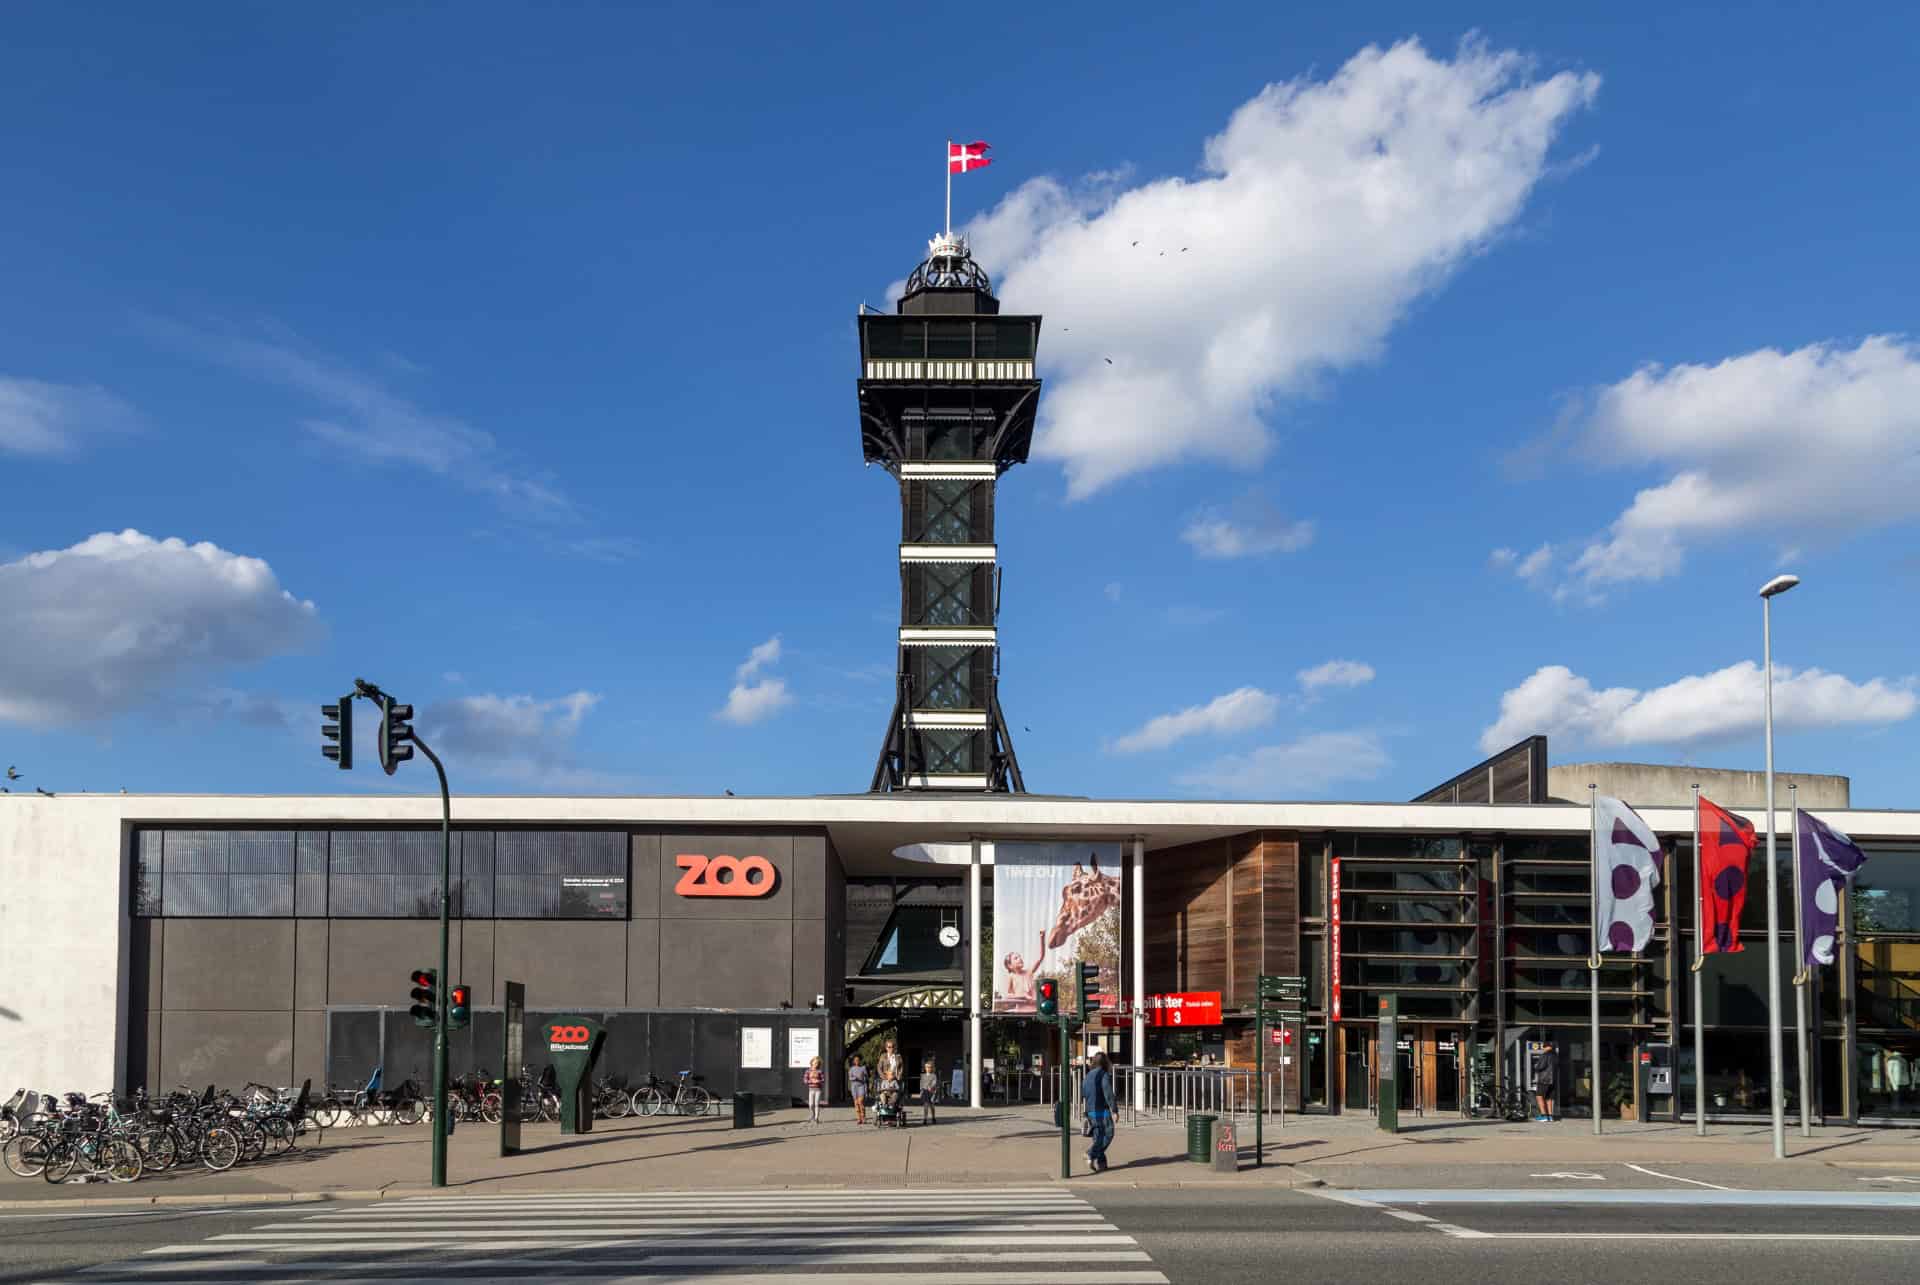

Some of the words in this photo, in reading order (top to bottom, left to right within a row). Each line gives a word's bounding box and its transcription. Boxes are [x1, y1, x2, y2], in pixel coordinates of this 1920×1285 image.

[674, 854, 776, 896] ZOO
[1173, 1011, 1182, 1024] 3
[551, 1025, 590, 1042] ZOO
